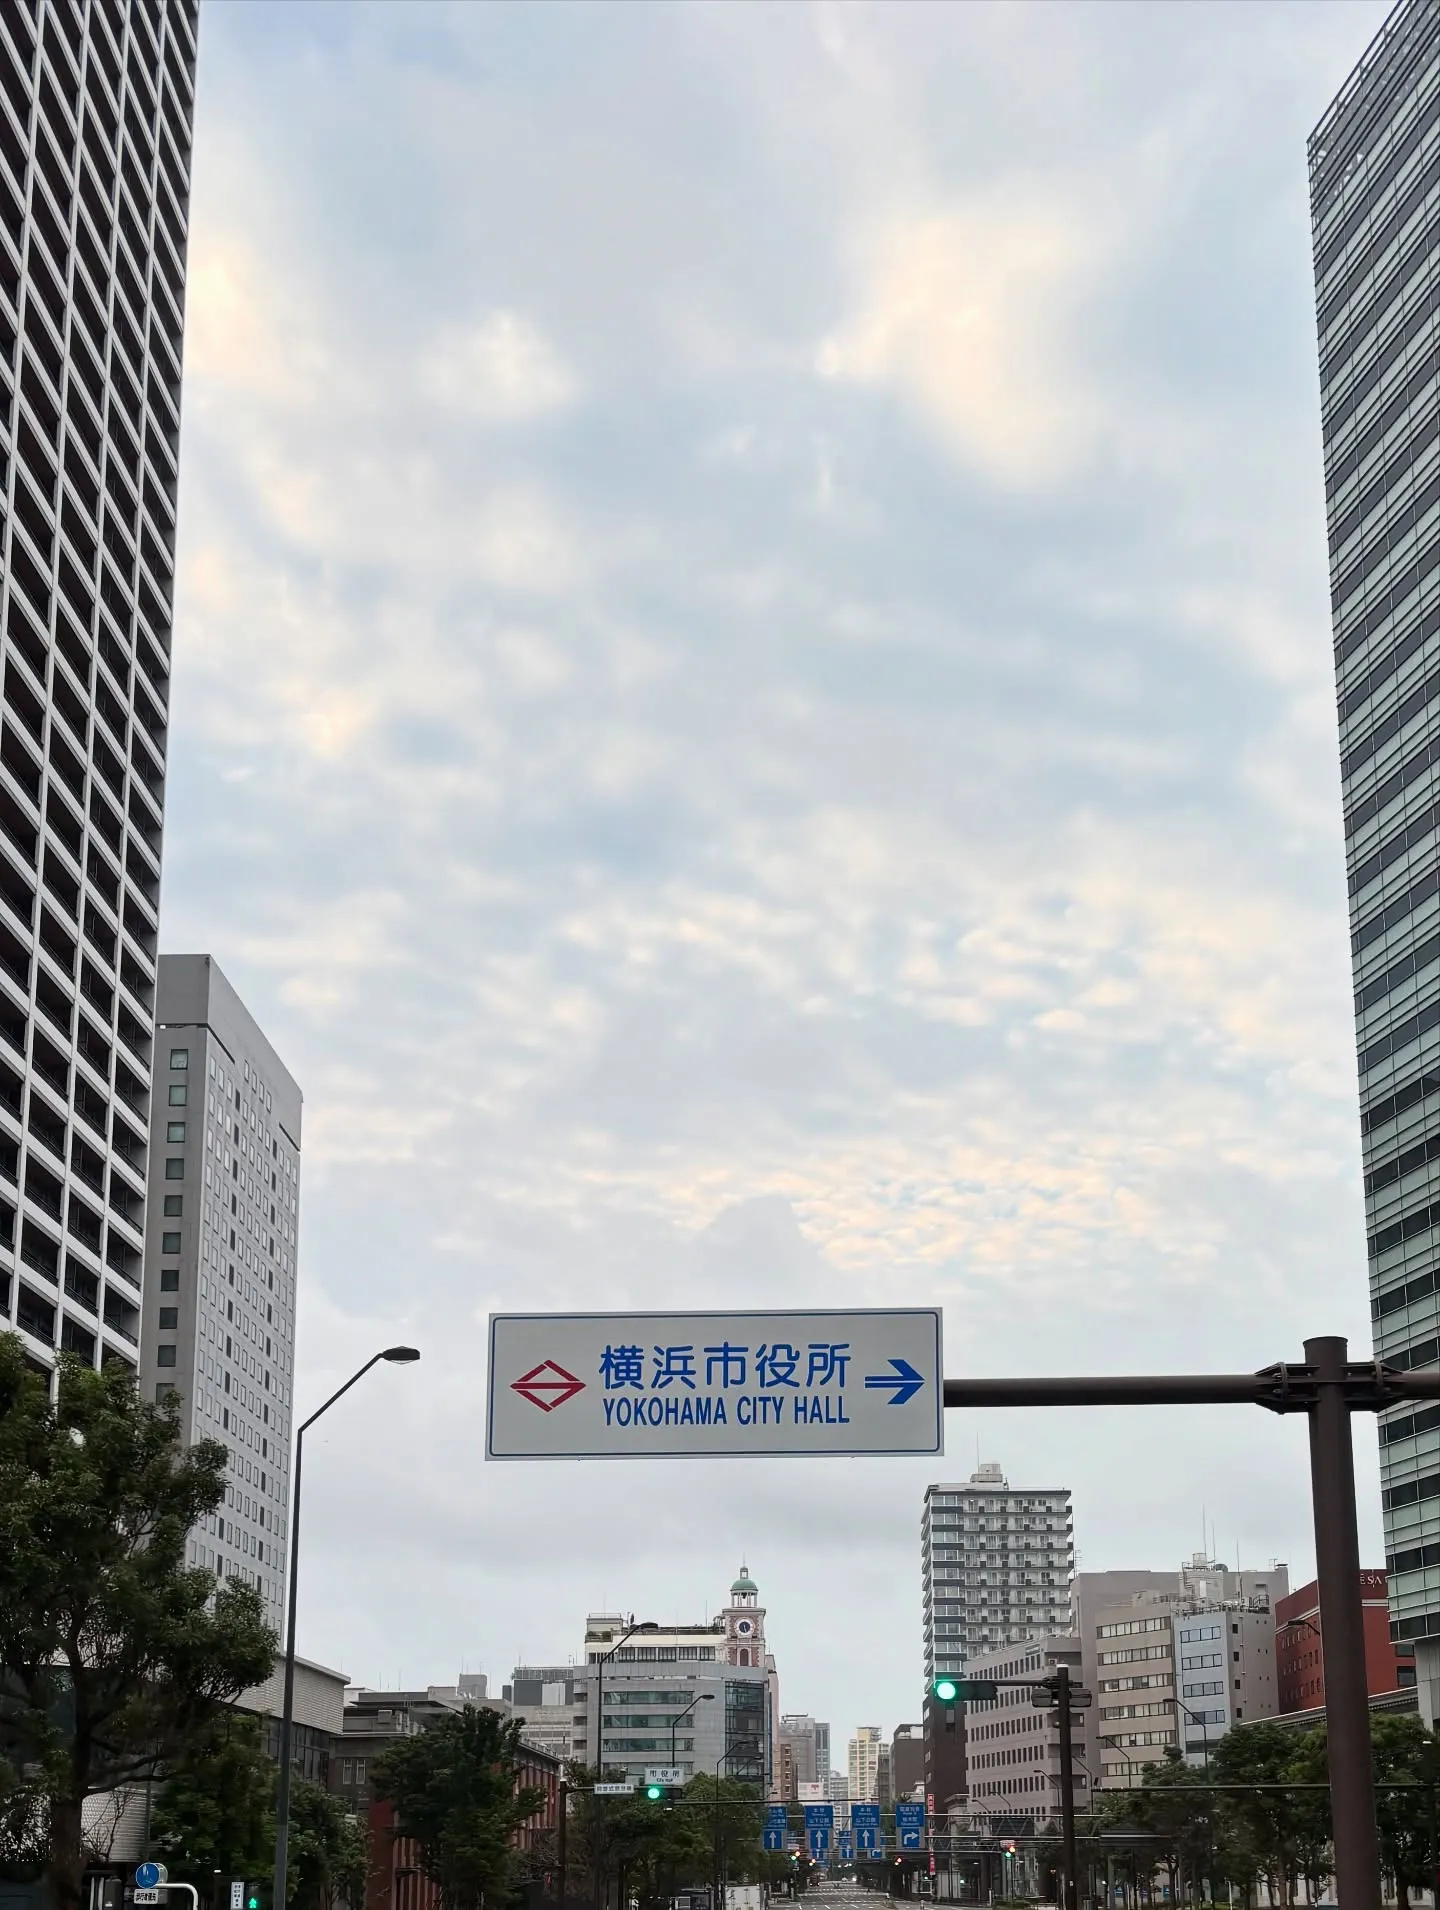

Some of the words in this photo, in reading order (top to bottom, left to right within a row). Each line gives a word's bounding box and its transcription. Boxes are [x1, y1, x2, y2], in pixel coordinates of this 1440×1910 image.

[599, 1341, 851, 1390] 横浜市役所
[603, 1396, 727, 1426] YOKOHAMA
[737, 1395, 784, 1425] CITY
[794, 1395, 850, 1424] HALL
